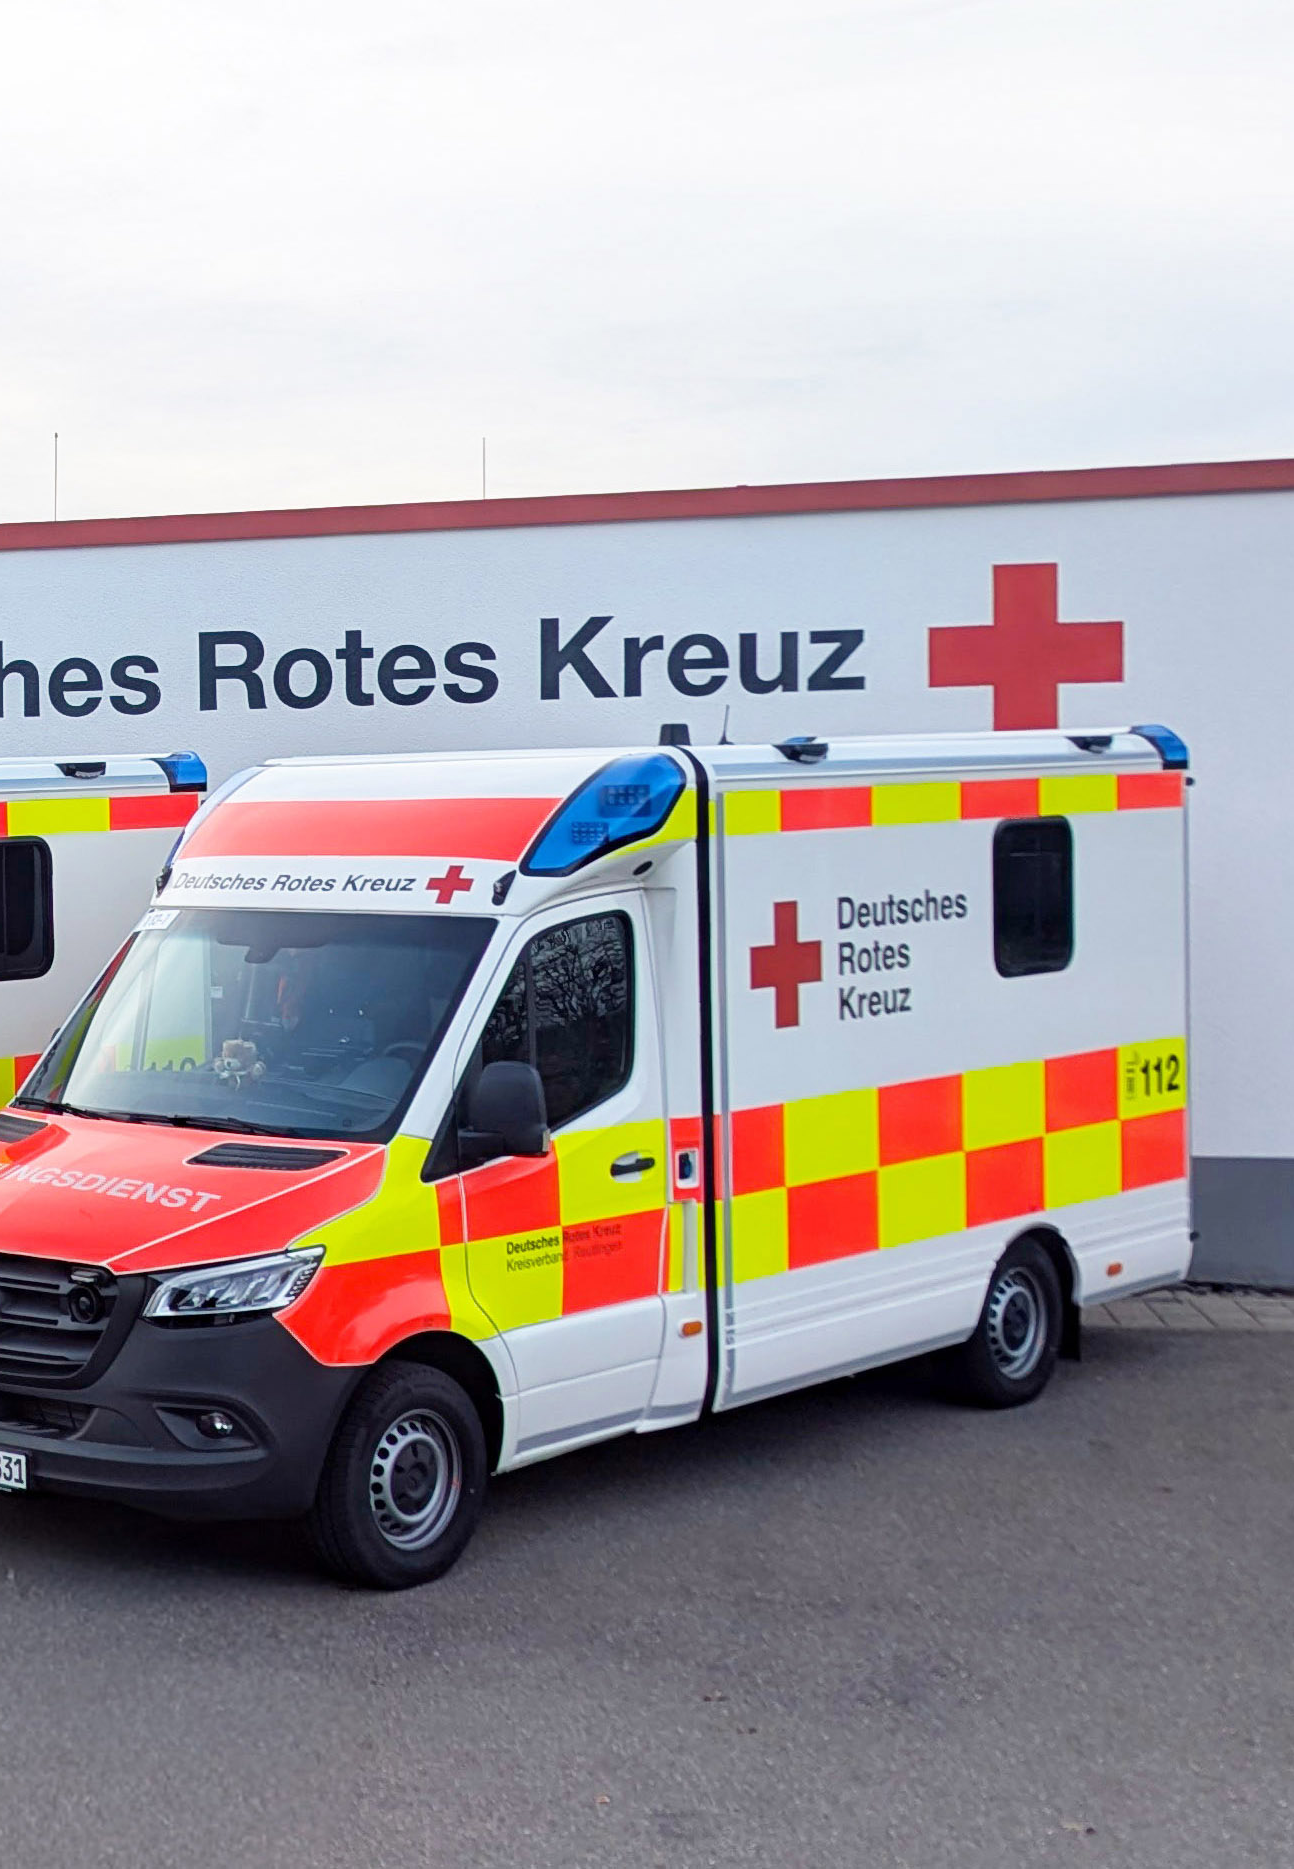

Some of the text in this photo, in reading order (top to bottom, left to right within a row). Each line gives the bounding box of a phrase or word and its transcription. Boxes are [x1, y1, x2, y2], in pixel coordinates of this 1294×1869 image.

[198, 629, 499, 711] Rotes
[540, 616, 865, 700] Kreuz
[173, 872, 416, 892] Deutsches Rotes Kreuz
[837, 889, 967, 929] Deutsches
[838, 940, 910, 975] Rotes
[839, 986, 912, 1021] Kreuz
[1140, 1054, 1180, 1096] 112
[506, 1235, 560, 1256] Deutsches
